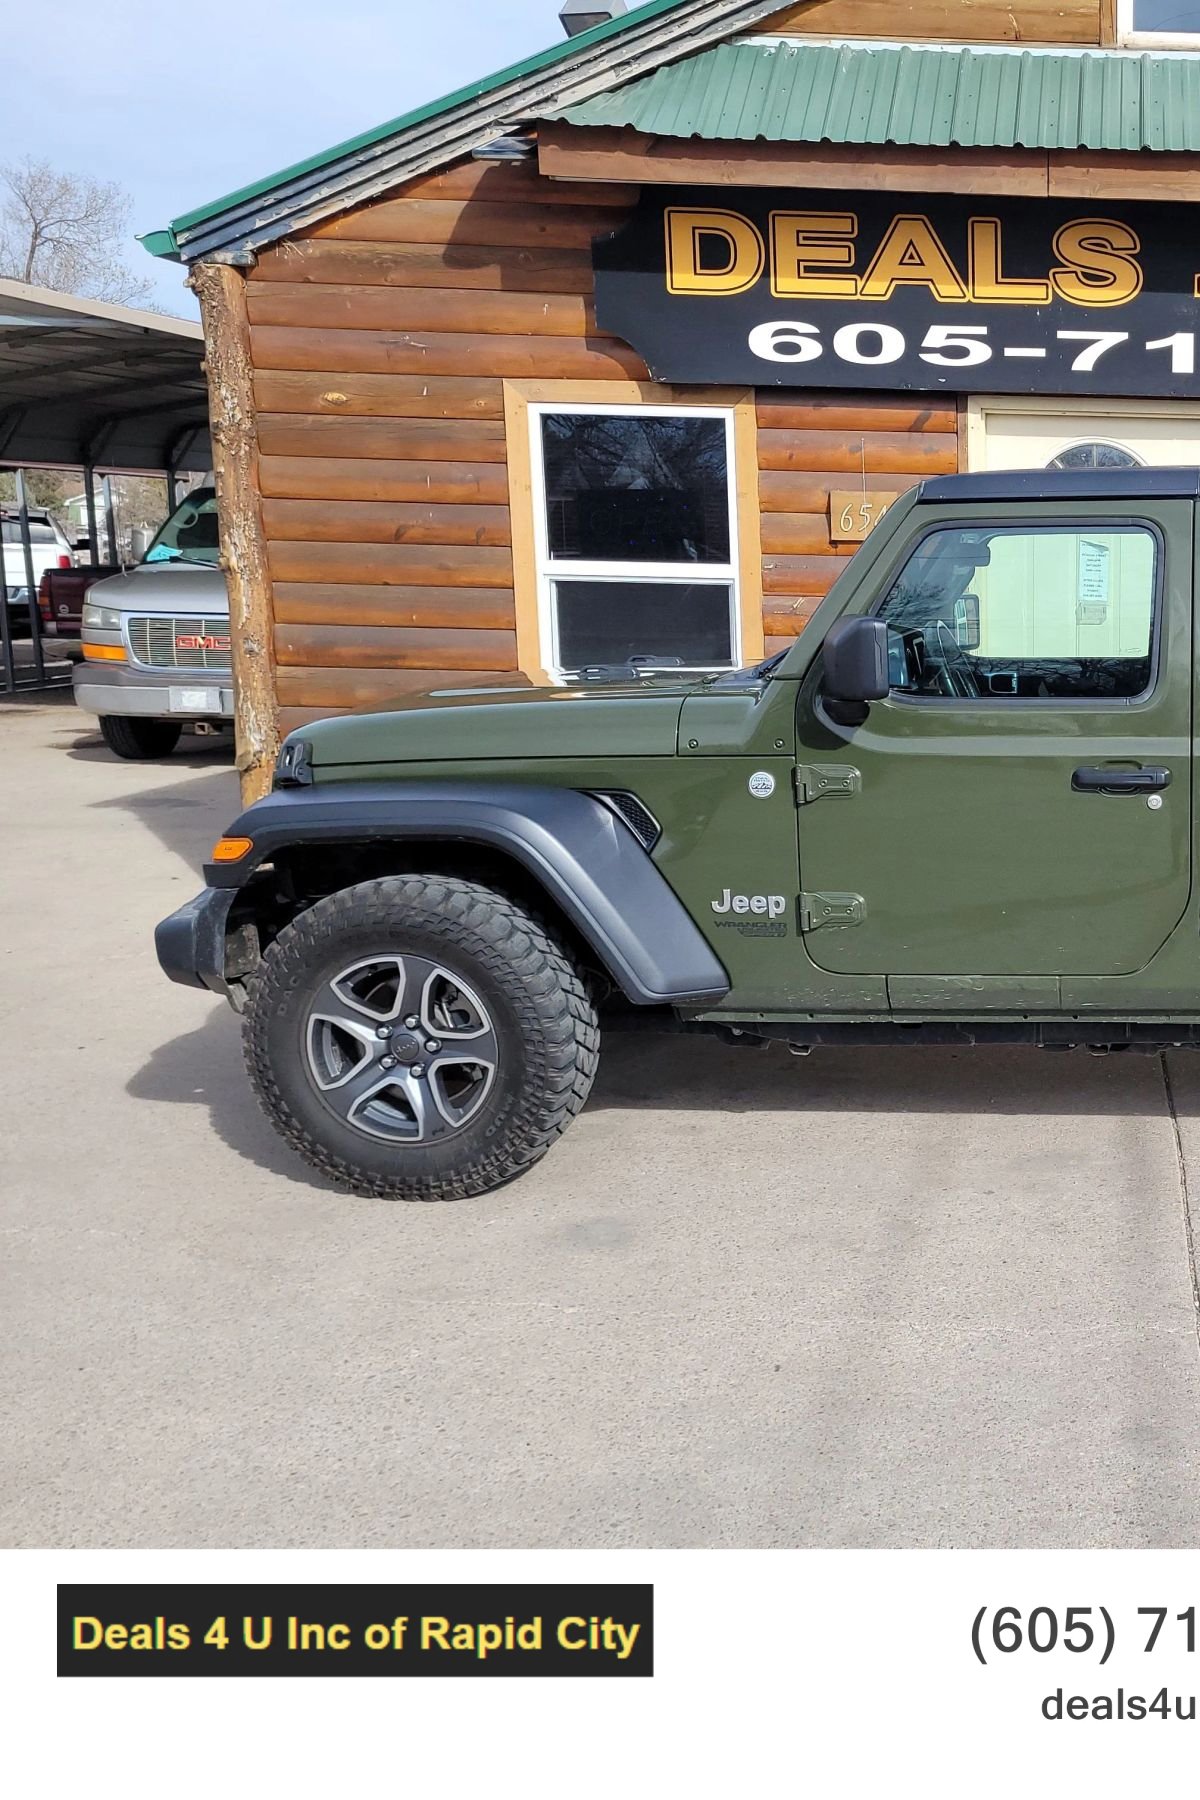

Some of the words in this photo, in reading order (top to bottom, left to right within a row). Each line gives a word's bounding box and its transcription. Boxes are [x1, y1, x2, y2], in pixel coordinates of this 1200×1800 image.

[665, 207, 1143, 307] DEALS
[176, 635, 231, 650] GMC
[711, 888, 786, 920] Jeep
